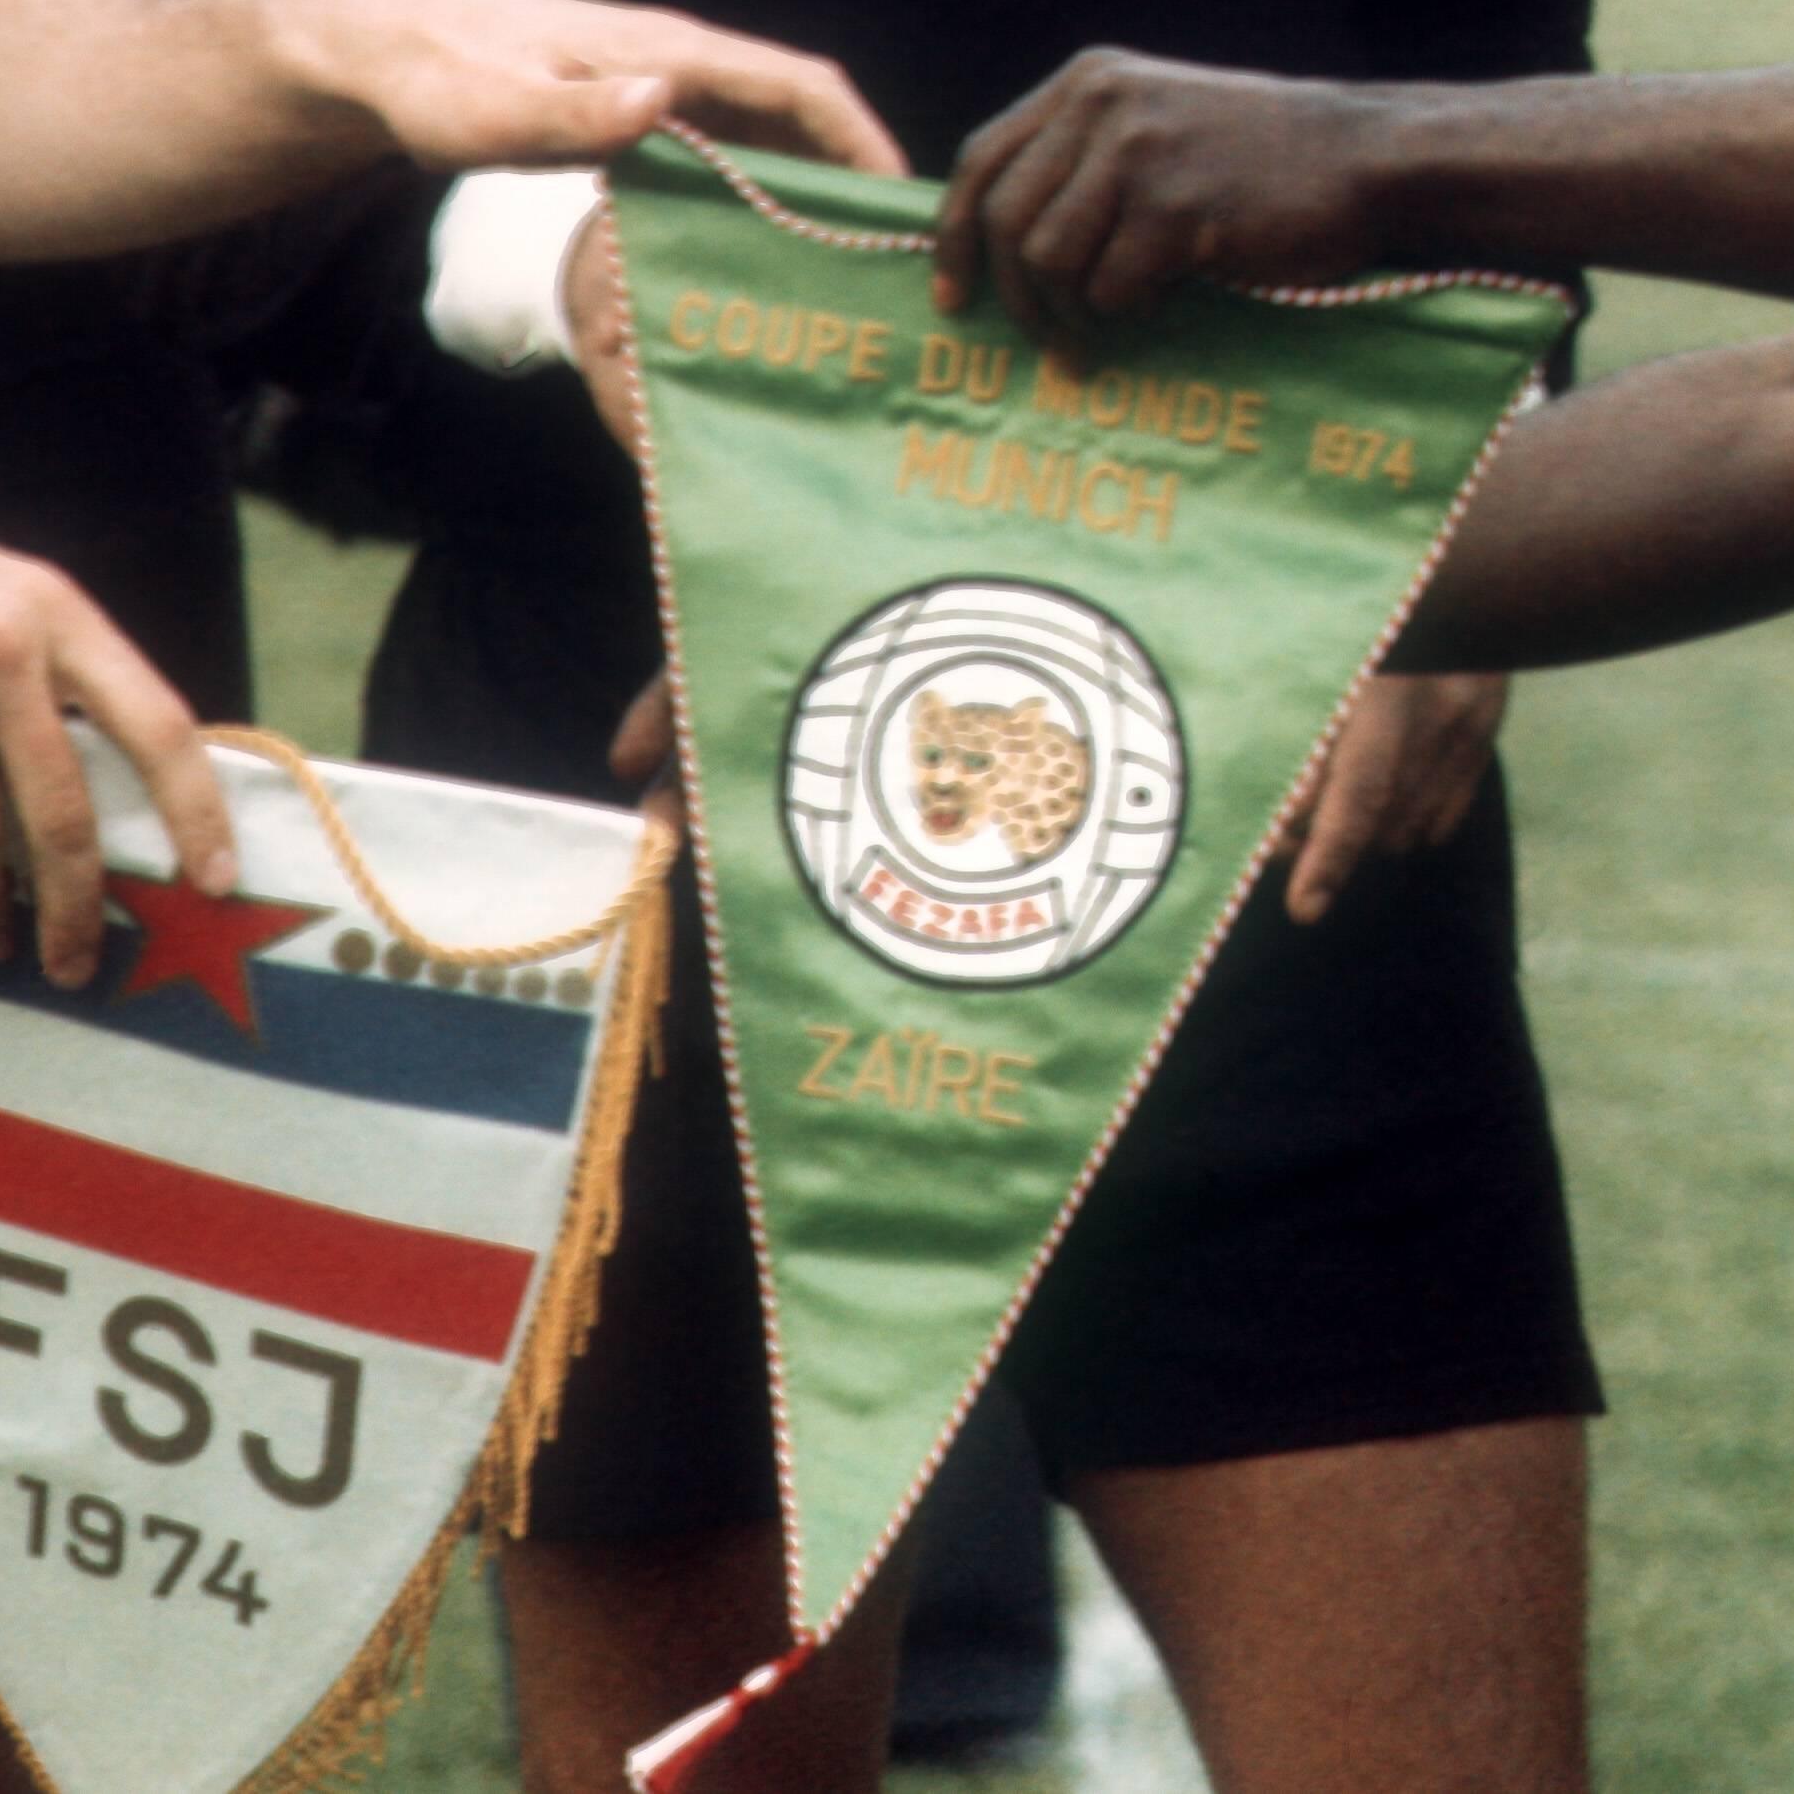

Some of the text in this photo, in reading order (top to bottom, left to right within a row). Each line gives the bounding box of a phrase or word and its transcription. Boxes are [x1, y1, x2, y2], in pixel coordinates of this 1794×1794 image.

[669, 290, 1417, 491] COUPE DU MONDE 1974
[896, 423, 1180, 542] MUNICH
[17, 1475, 270, 1627] 1974
